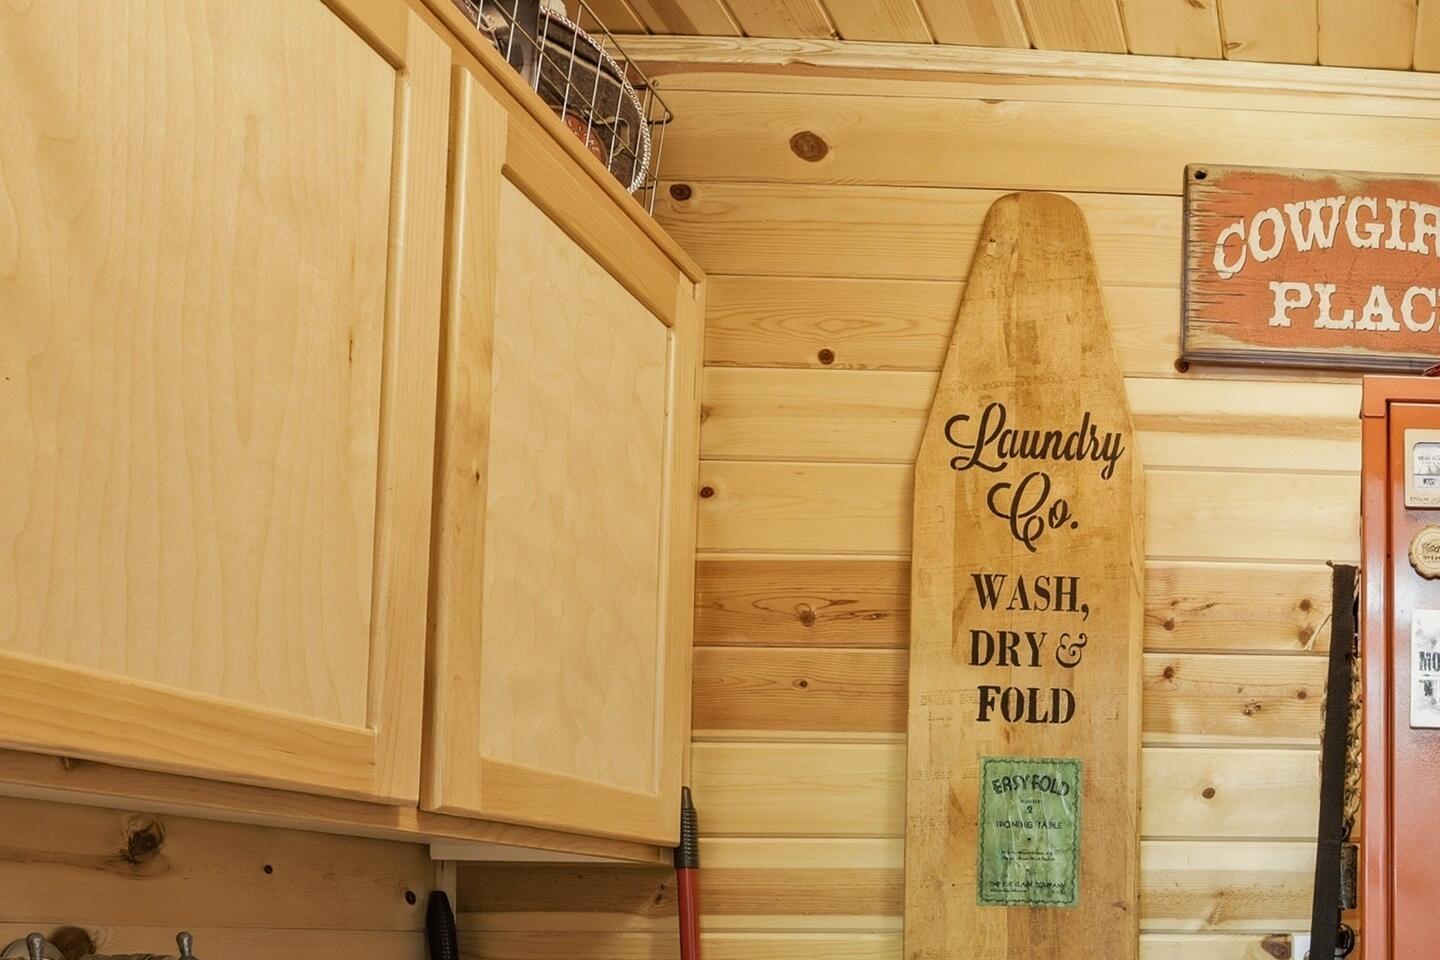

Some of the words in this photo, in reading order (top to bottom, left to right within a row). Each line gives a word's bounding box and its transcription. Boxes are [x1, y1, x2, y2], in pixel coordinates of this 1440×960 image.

[944, 402, 1126, 481] Laundry
[987, 471, 1079, 553] Co.
[970, 573, 1090, 621] WASH,
[968, 629, 1047, 668] DRY
[1055, 632, 1088, 669] &
[975, 685, 1076, 724] FOLD
